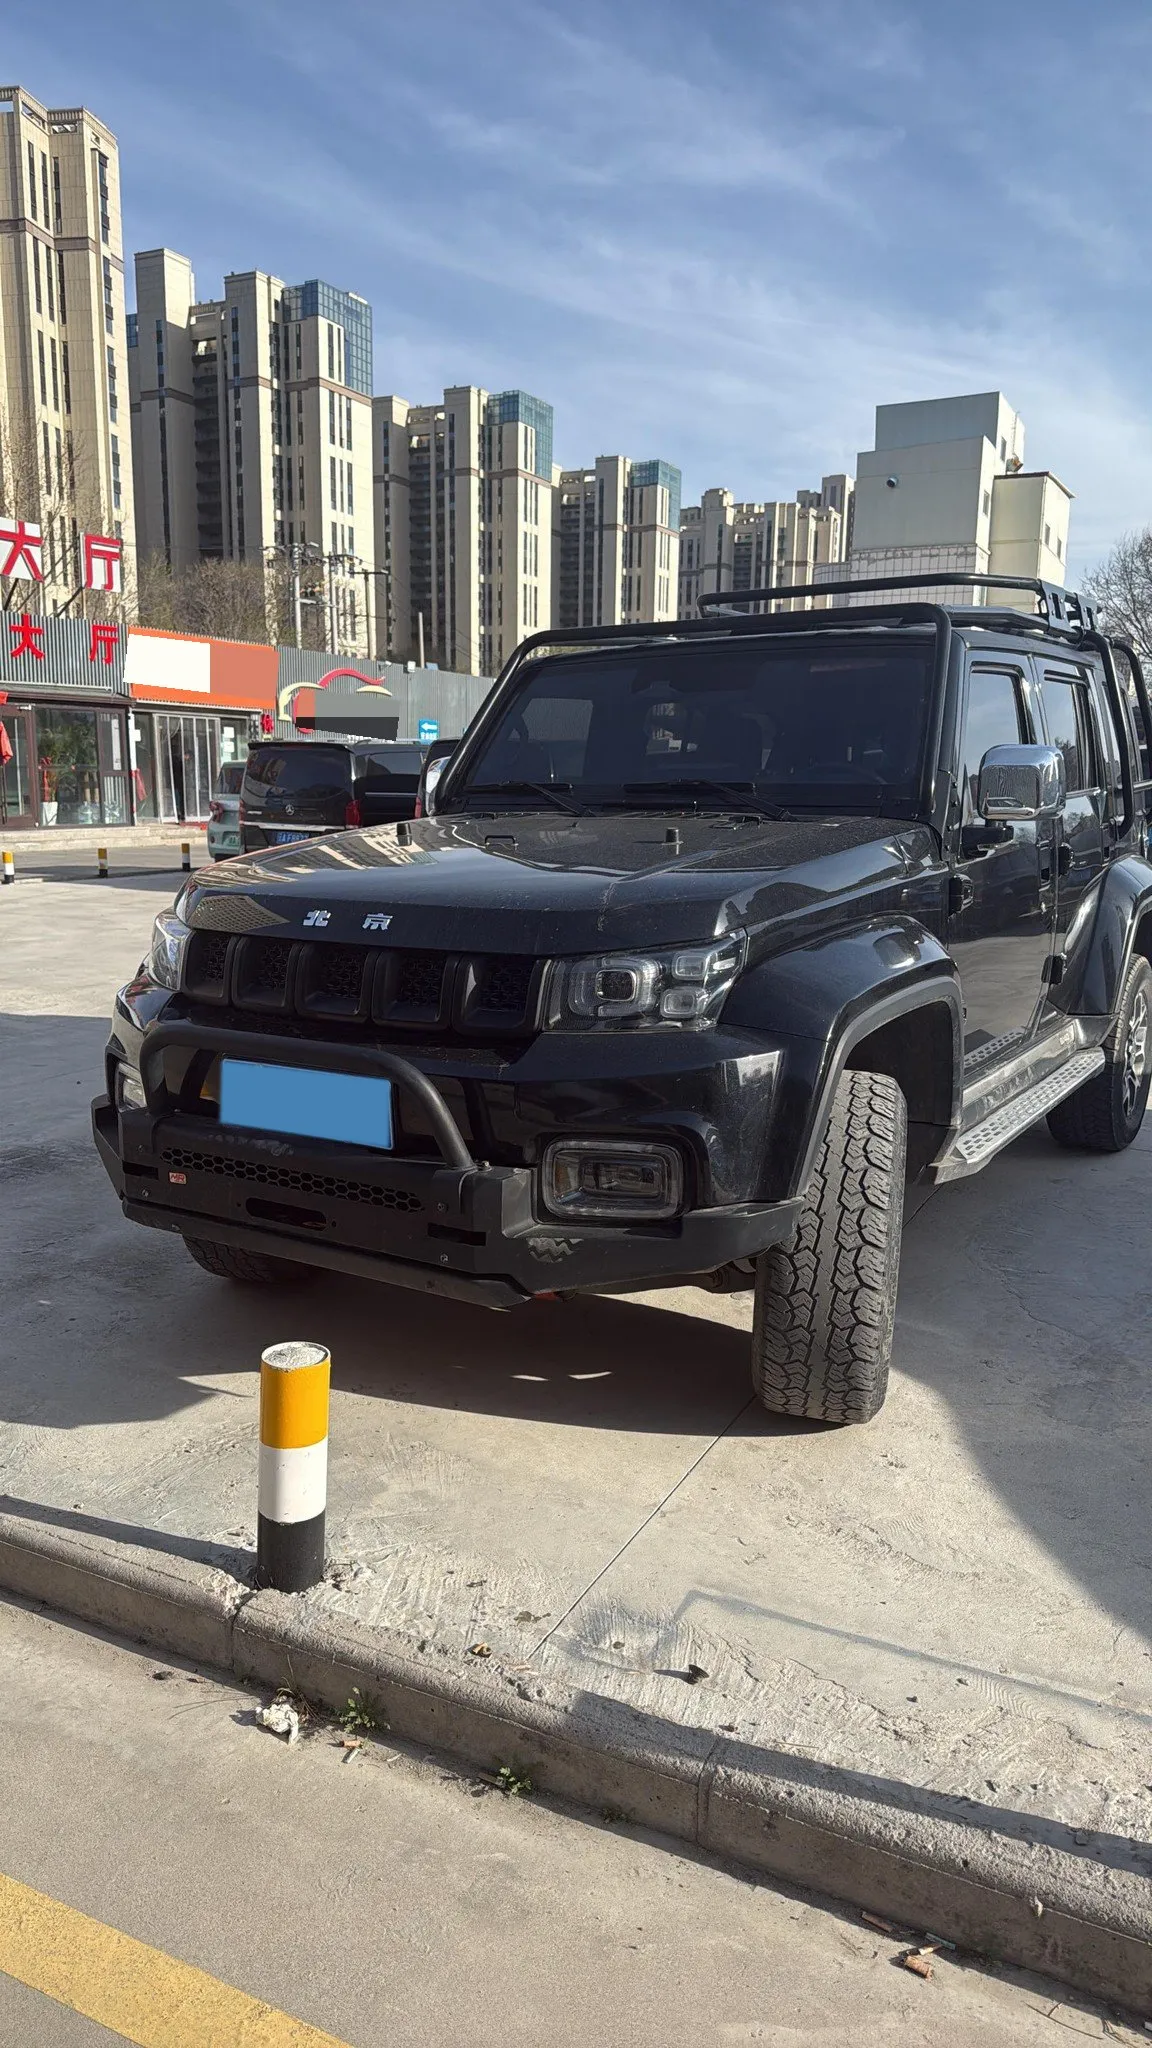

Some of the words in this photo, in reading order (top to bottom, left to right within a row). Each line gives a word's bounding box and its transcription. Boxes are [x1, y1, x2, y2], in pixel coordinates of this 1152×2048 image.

[0, 520, 121, 592] 大厅
[9, 613, 118, 664] 大厅
[302, 909, 393, 931] 北京
